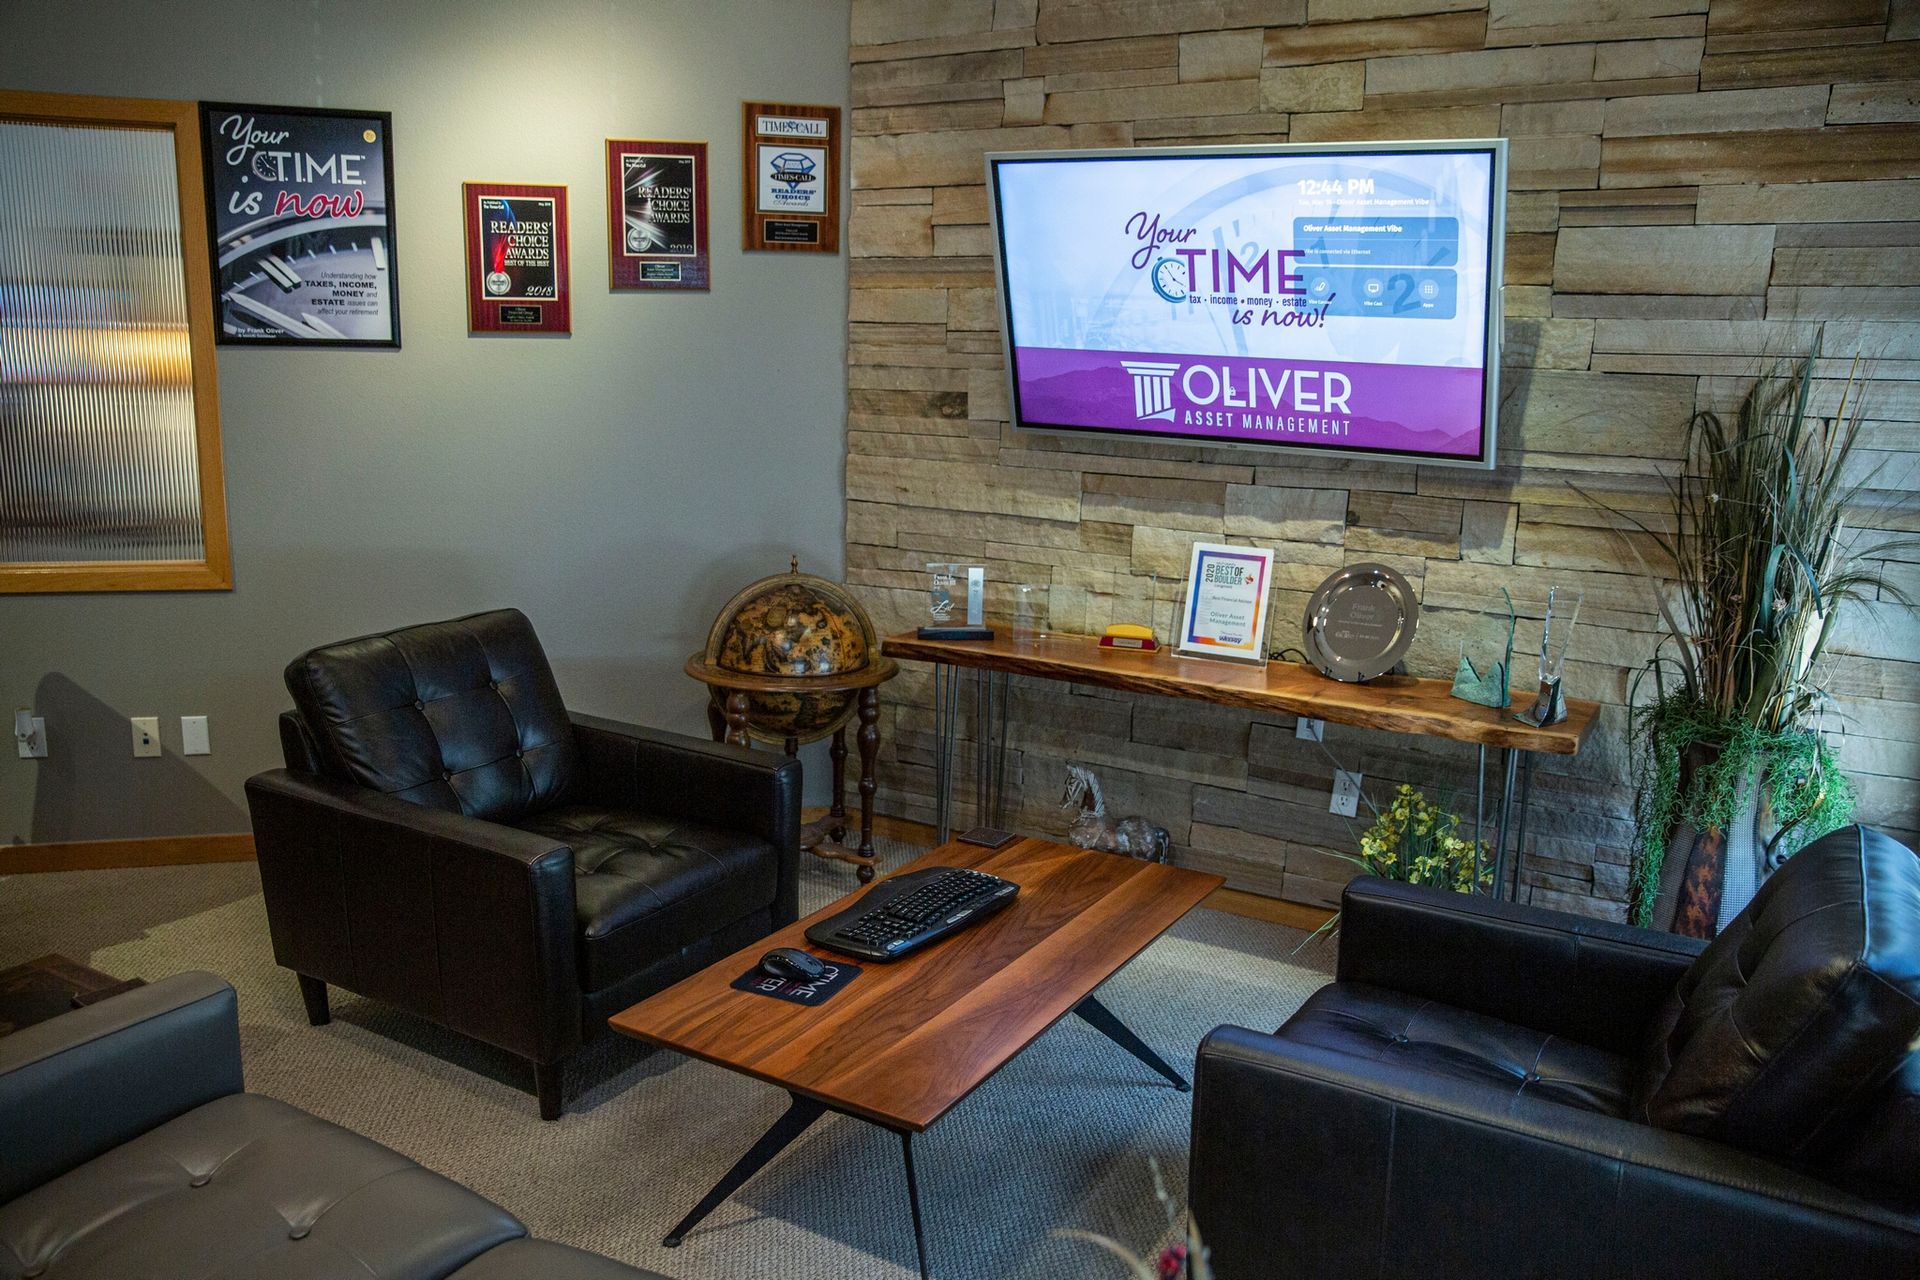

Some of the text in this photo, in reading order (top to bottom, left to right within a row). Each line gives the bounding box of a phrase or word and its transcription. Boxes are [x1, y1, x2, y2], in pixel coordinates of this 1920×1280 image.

[762, 120, 822, 134] TIMES-CALL
[220, 115, 289, 165] Your
[1297, 179, 1374, 195] 12:44 PM
[229, 176, 364, 219] is now
[651, 200, 690, 211] CHOICE
[648, 212, 690, 223] AWARDS
[491, 220, 551, 234] READERS'
[1303, 224, 1323, 232] Oliver
[1343, 225, 1386, 234] Management
[1386, 224, 1403, 232] Vibe
[507, 235, 549, 247] CHOICE
[1125, 211, 1197, 270] Your
[505, 248, 549, 259] AWARDS
[321, 272, 363, 280] Understanding
[1176, 248, 1307, 295] TIME
[305, 280, 377, 290] TAXES, INCOME,
[525, 285, 553, 296] 2018
[1189, 294, 1307, 308] tax income money estate
[1232, 292, 1336, 328] is now!
[1182, 364, 1352, 414] OLIVER
[1184, 410, 1350, 436] ASSET MANAGEMENT
[1205, 564, 1215, 583] 2020
[1216, 565, 1244, 576] BEST OF
[1214, 575, 1243, 585] BOULDER
